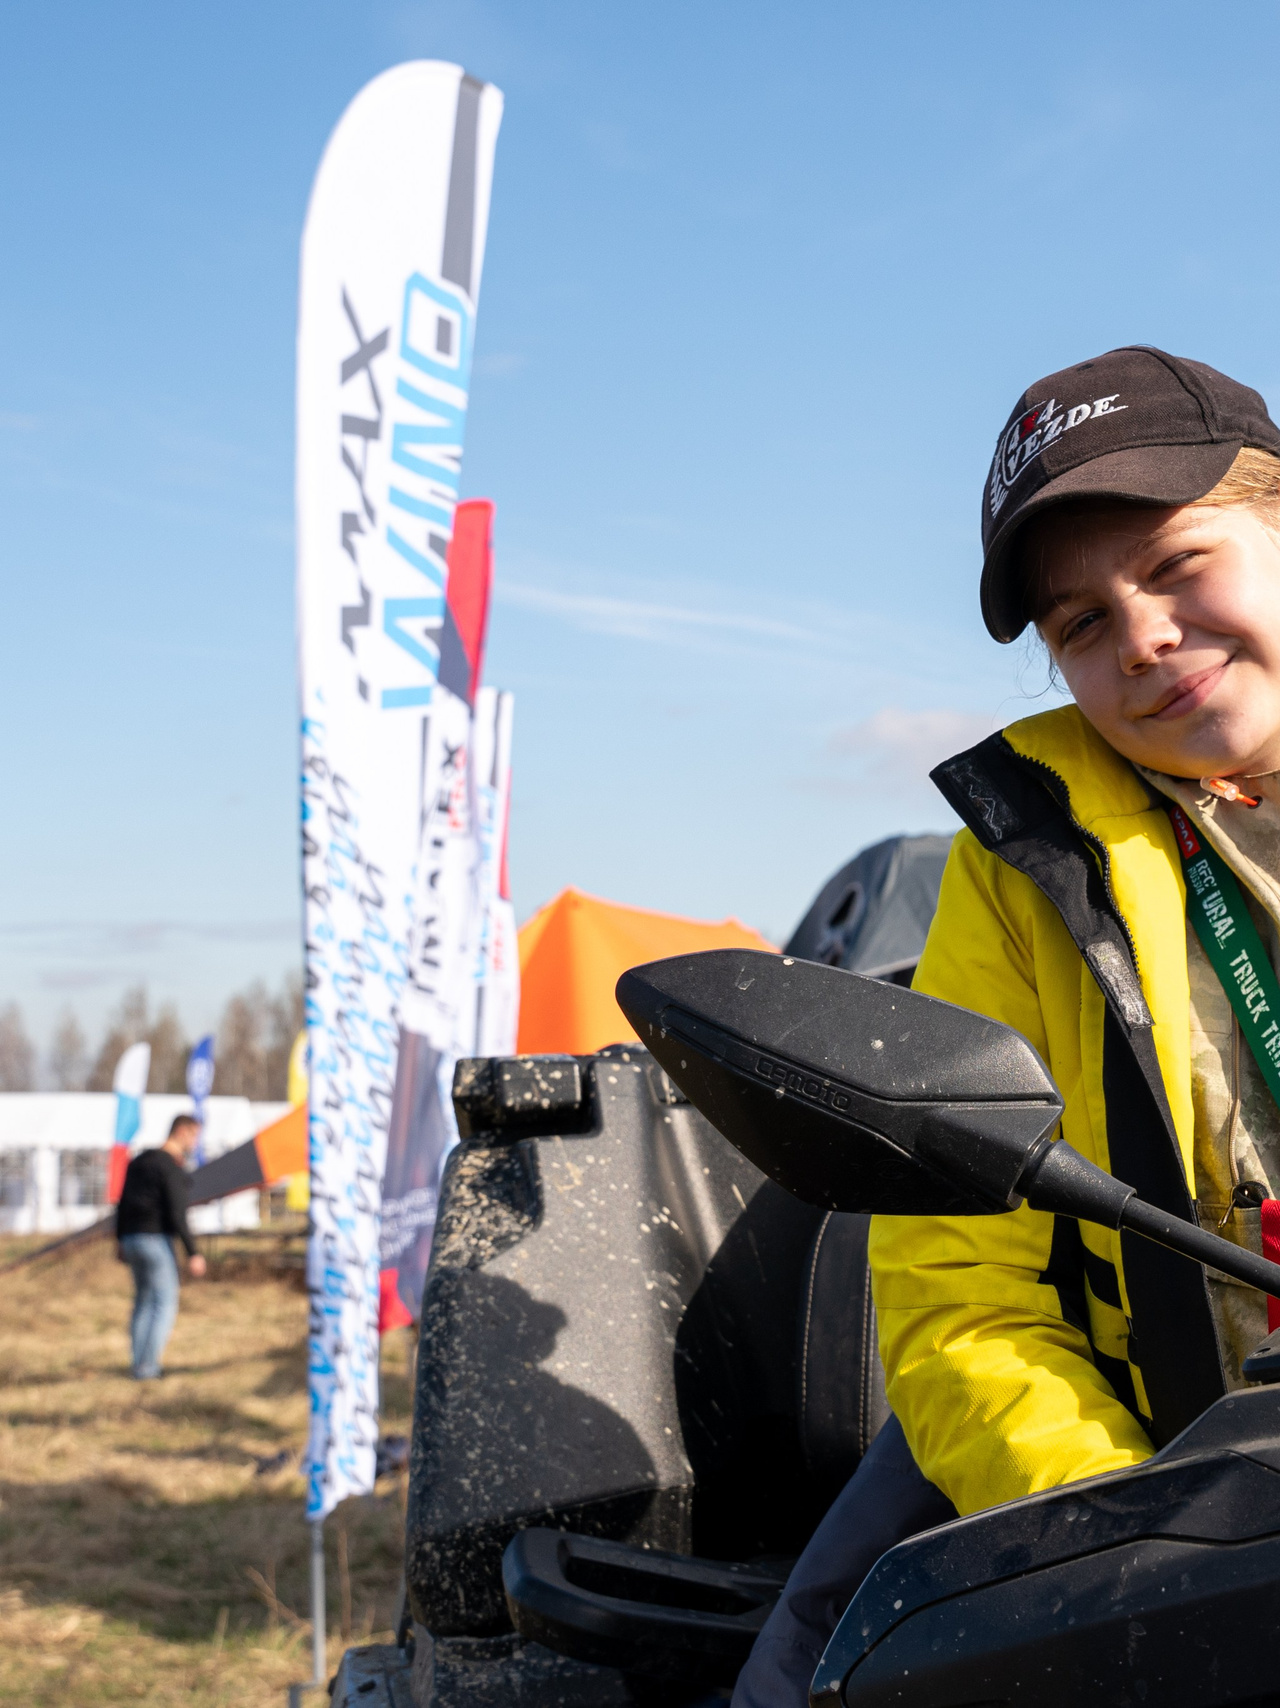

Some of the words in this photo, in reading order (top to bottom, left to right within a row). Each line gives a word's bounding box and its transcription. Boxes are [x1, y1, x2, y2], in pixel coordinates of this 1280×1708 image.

[1007, 394, 1128, 478] VEZDE
[1186, 866, 1206, 896] RUSSIA
[1201, 889, 1237, 950] URAL
[1229, 949, 1270, 1024] TRUCK
